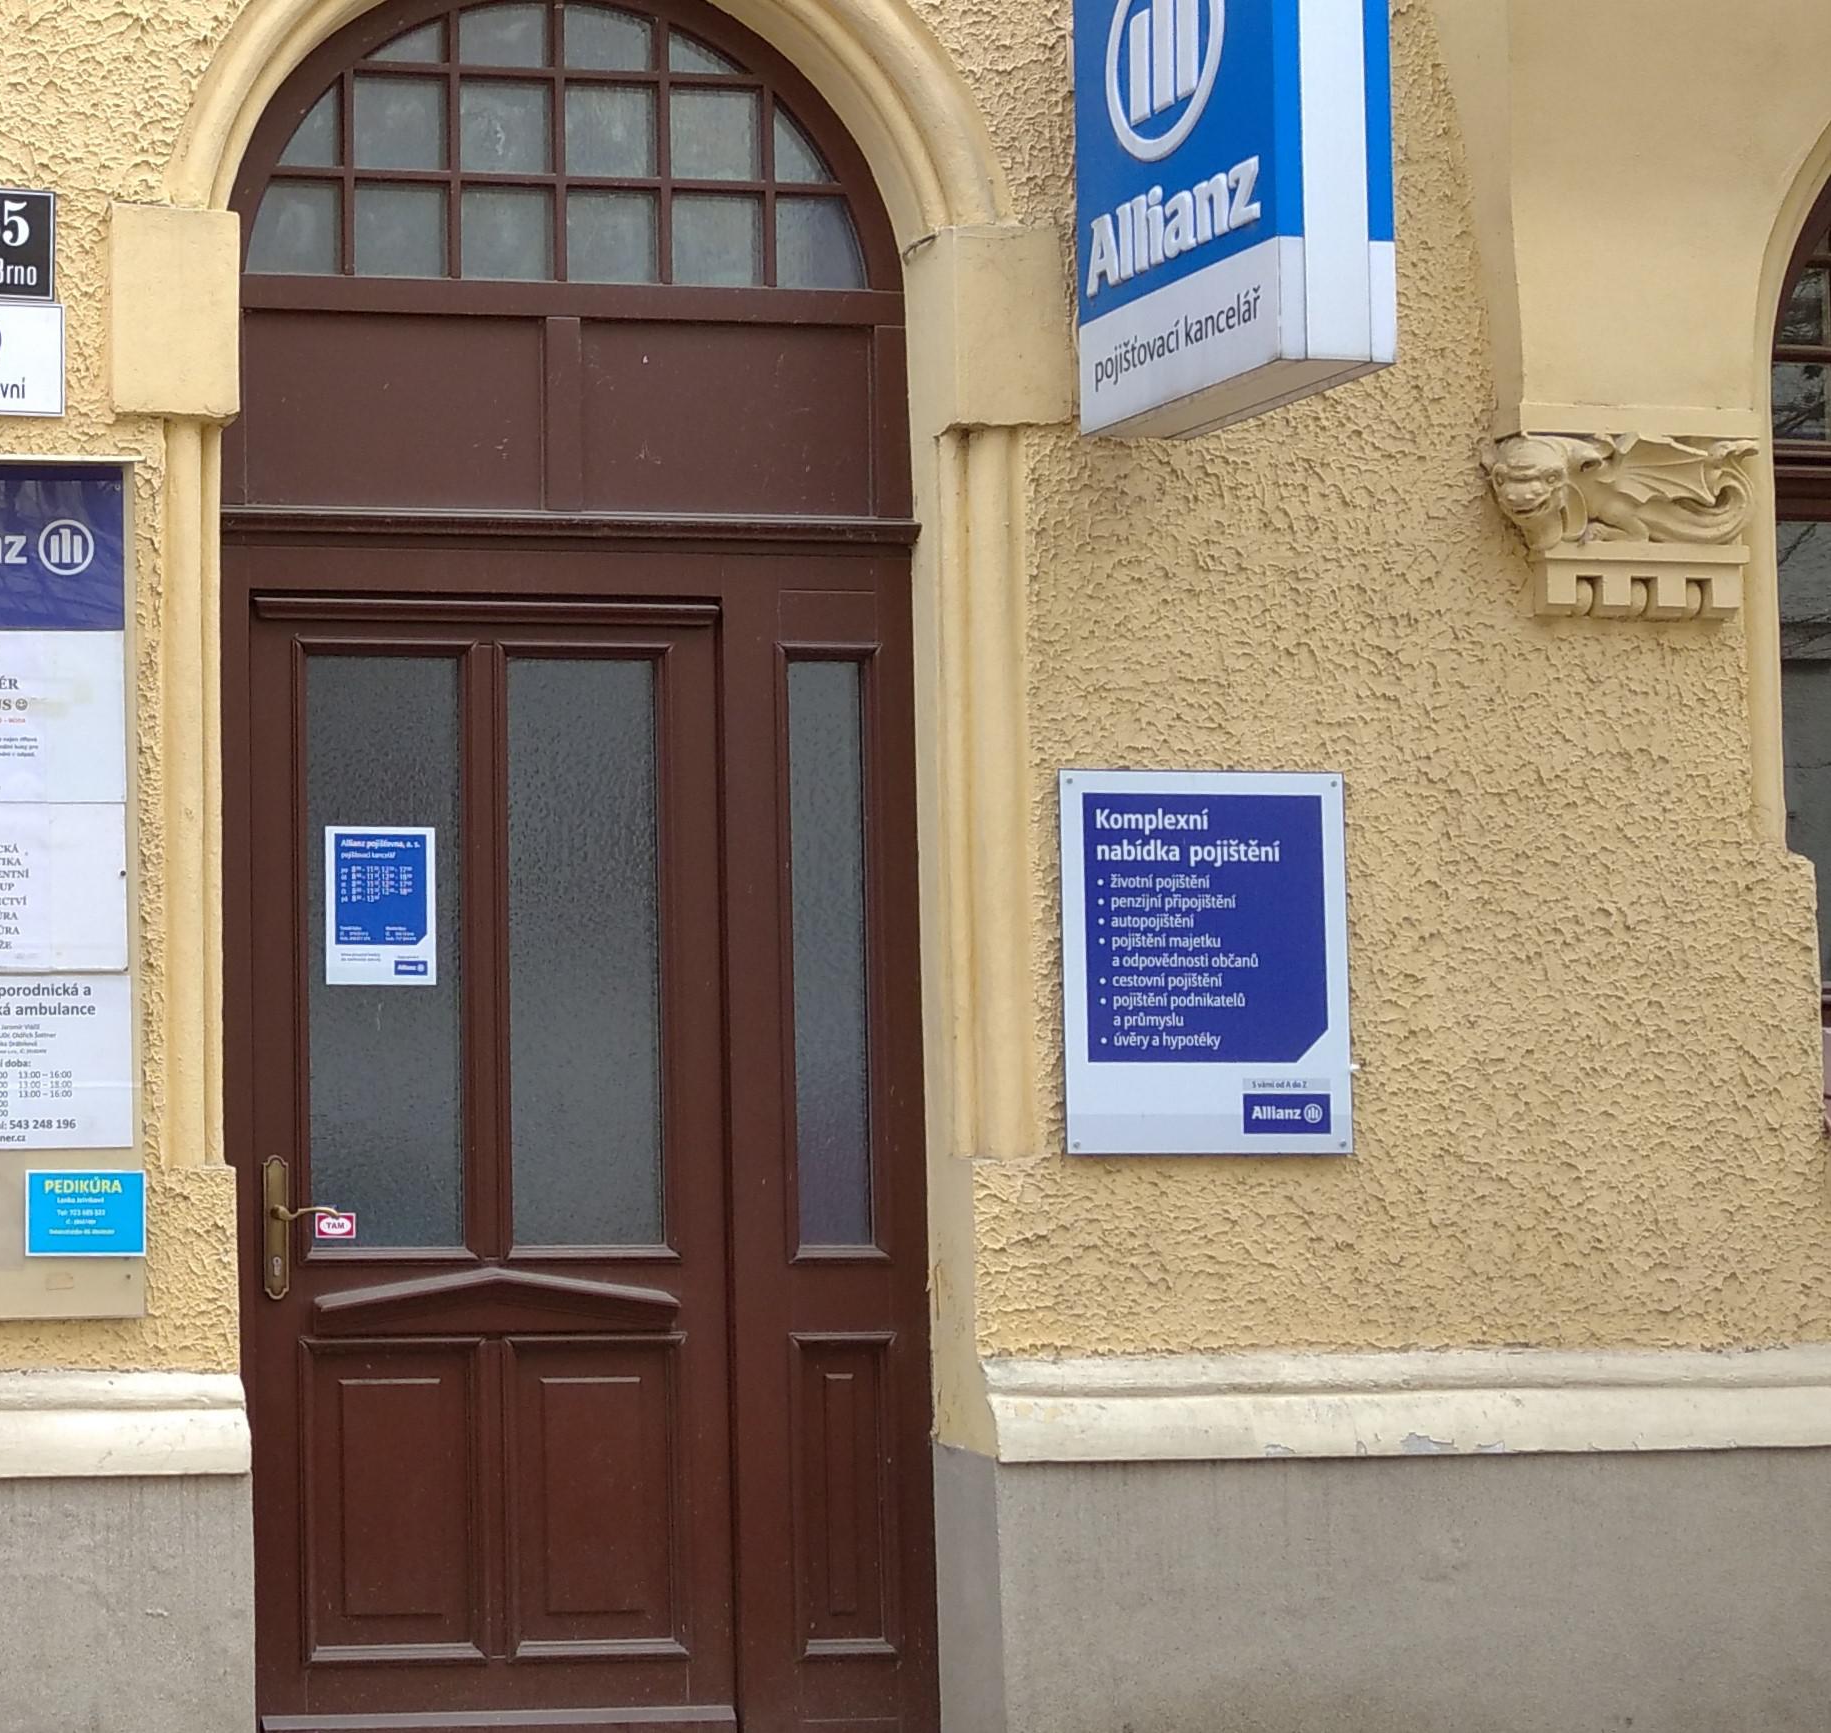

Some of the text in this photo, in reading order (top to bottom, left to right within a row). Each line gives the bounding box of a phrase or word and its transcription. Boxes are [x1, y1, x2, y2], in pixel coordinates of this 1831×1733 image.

[1086, 155, 1261, 297] Allianz
[1094, 286, 1261, 392] pojišťovací kancelář
[1095, 808, 1209, 835] Komplexní
[341, 839, 365, 847] Allianz
[1096, 838, 1280, 867] nabídka pojištění
[1110, 873, 1210, 892] životní pojištění
[1110, 894, 1236, 912] penzijní připojištění
[1111, 913, 1194, 931] autopojištění
[1112, 933, 1222, 951] pojištění majetku
[1112, 953, 1259, 970] a odpovědnosti občanů
[1112, 973, 1222, 990] cestovní pojištění
[83, 987, 91, 996] a
[15, 1003, 96, 1016] ambulance
[1113, 992, 1246, 1010] pojištění podnikatelů
[1113, 1012, 1184, 1030] a průmyslu
[1114, 1032, 1221, 1050] úvěry a hypotéky
[5, 1059, 31, 1068] doba:
[19, 1071, 40, 1079] 13:00
[50, 1071, 72, 1079] 16:00
[19, 1090, 40, 1098] 13:00
[50, 1090, 72, 1098] 16:00
[1252, 1105, 1302, 1119] Allianz
[9, 1119, 30, 1129] 543
[33, 1119, 53, 1129] 248
[56, 1119, 76, 1129] 196
